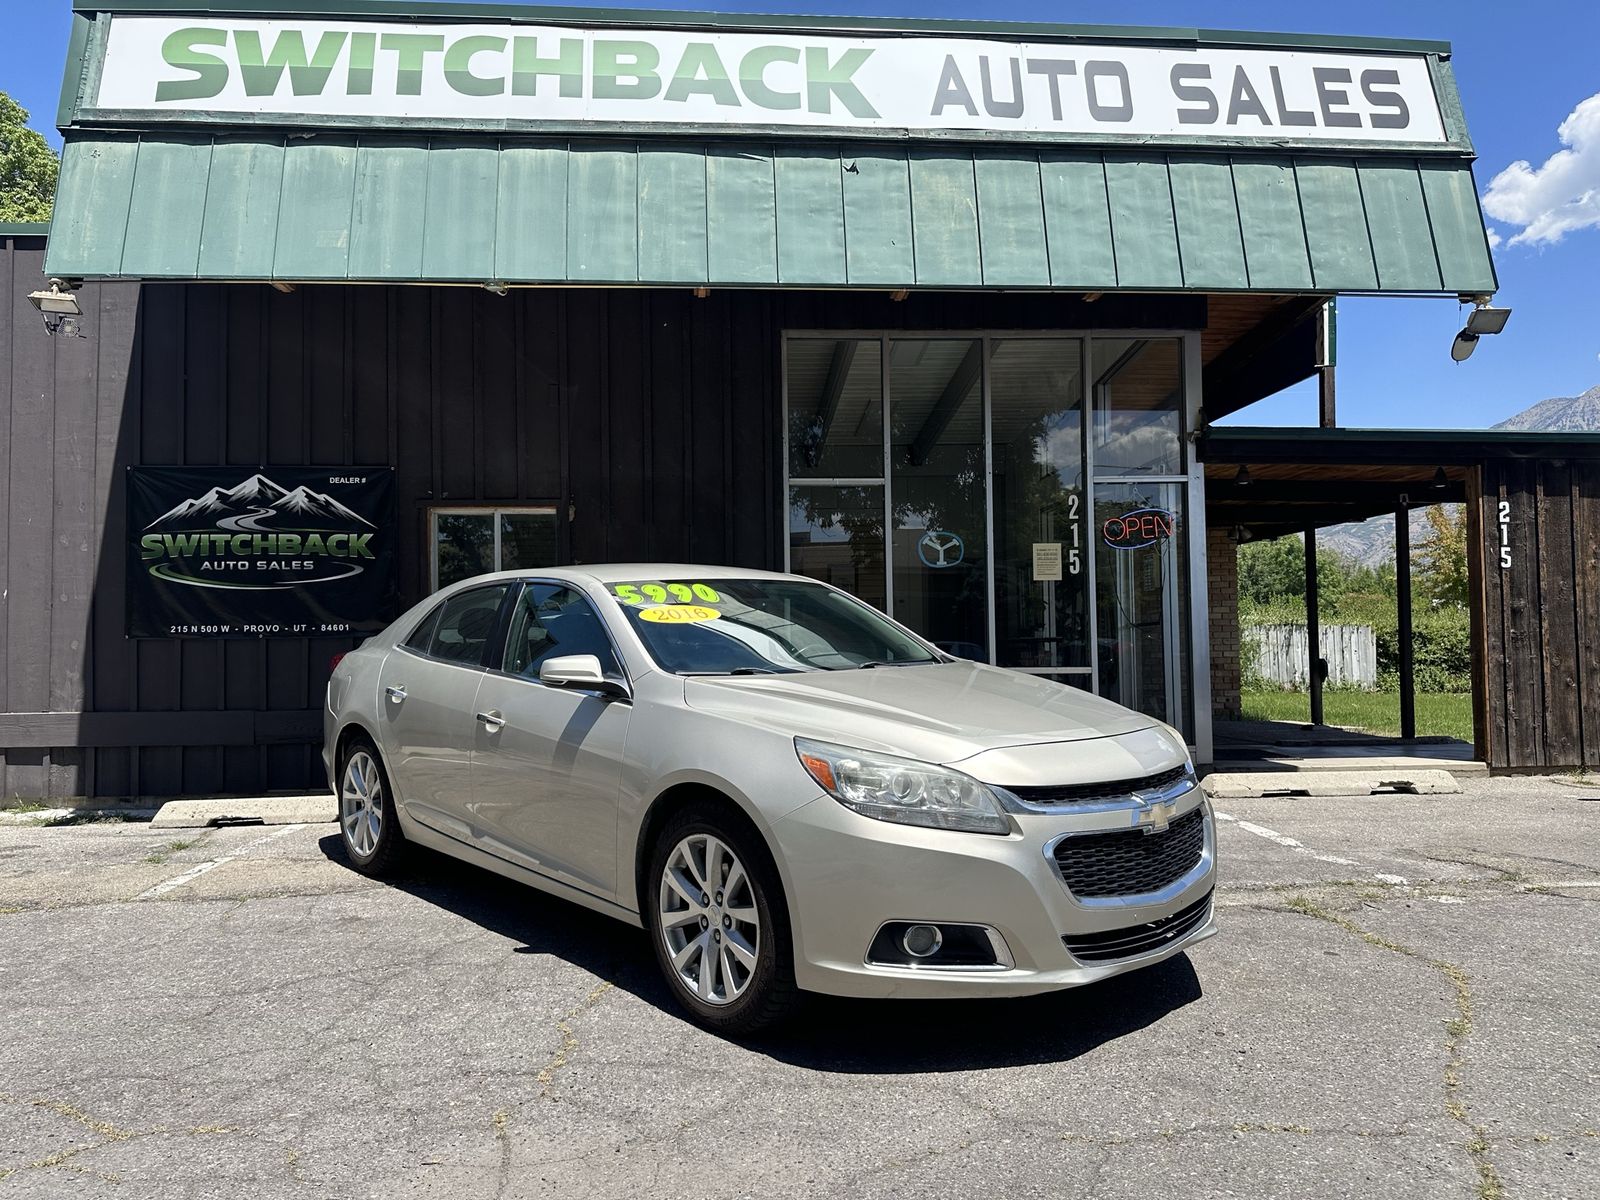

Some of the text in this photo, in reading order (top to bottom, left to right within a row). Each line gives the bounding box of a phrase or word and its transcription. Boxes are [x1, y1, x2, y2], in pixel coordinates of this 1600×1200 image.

[155, 27, 1410, 129] SWITCHBACK AUTO SALES
[1068, 494, 1080, 574] 215
[1103, 515, 1172, 541] OPEN
[1499, 501, 1512, 569] 215
[141, 533, 376, 560] SWITCHBACK
[200, 560, 314, 571] AUTO SALES
[614, 583, 720, 605] 5990
[652, 608, 708, 621] 2016
[170, 625, 188, 633] 215
[191, 625, 198, 633] N
[200, 625, 218, 633] 500
[243, 624, 280, 632] PROVO
[293, 624, 307, 632] UT
[320, 624, 350, 632] 84601
